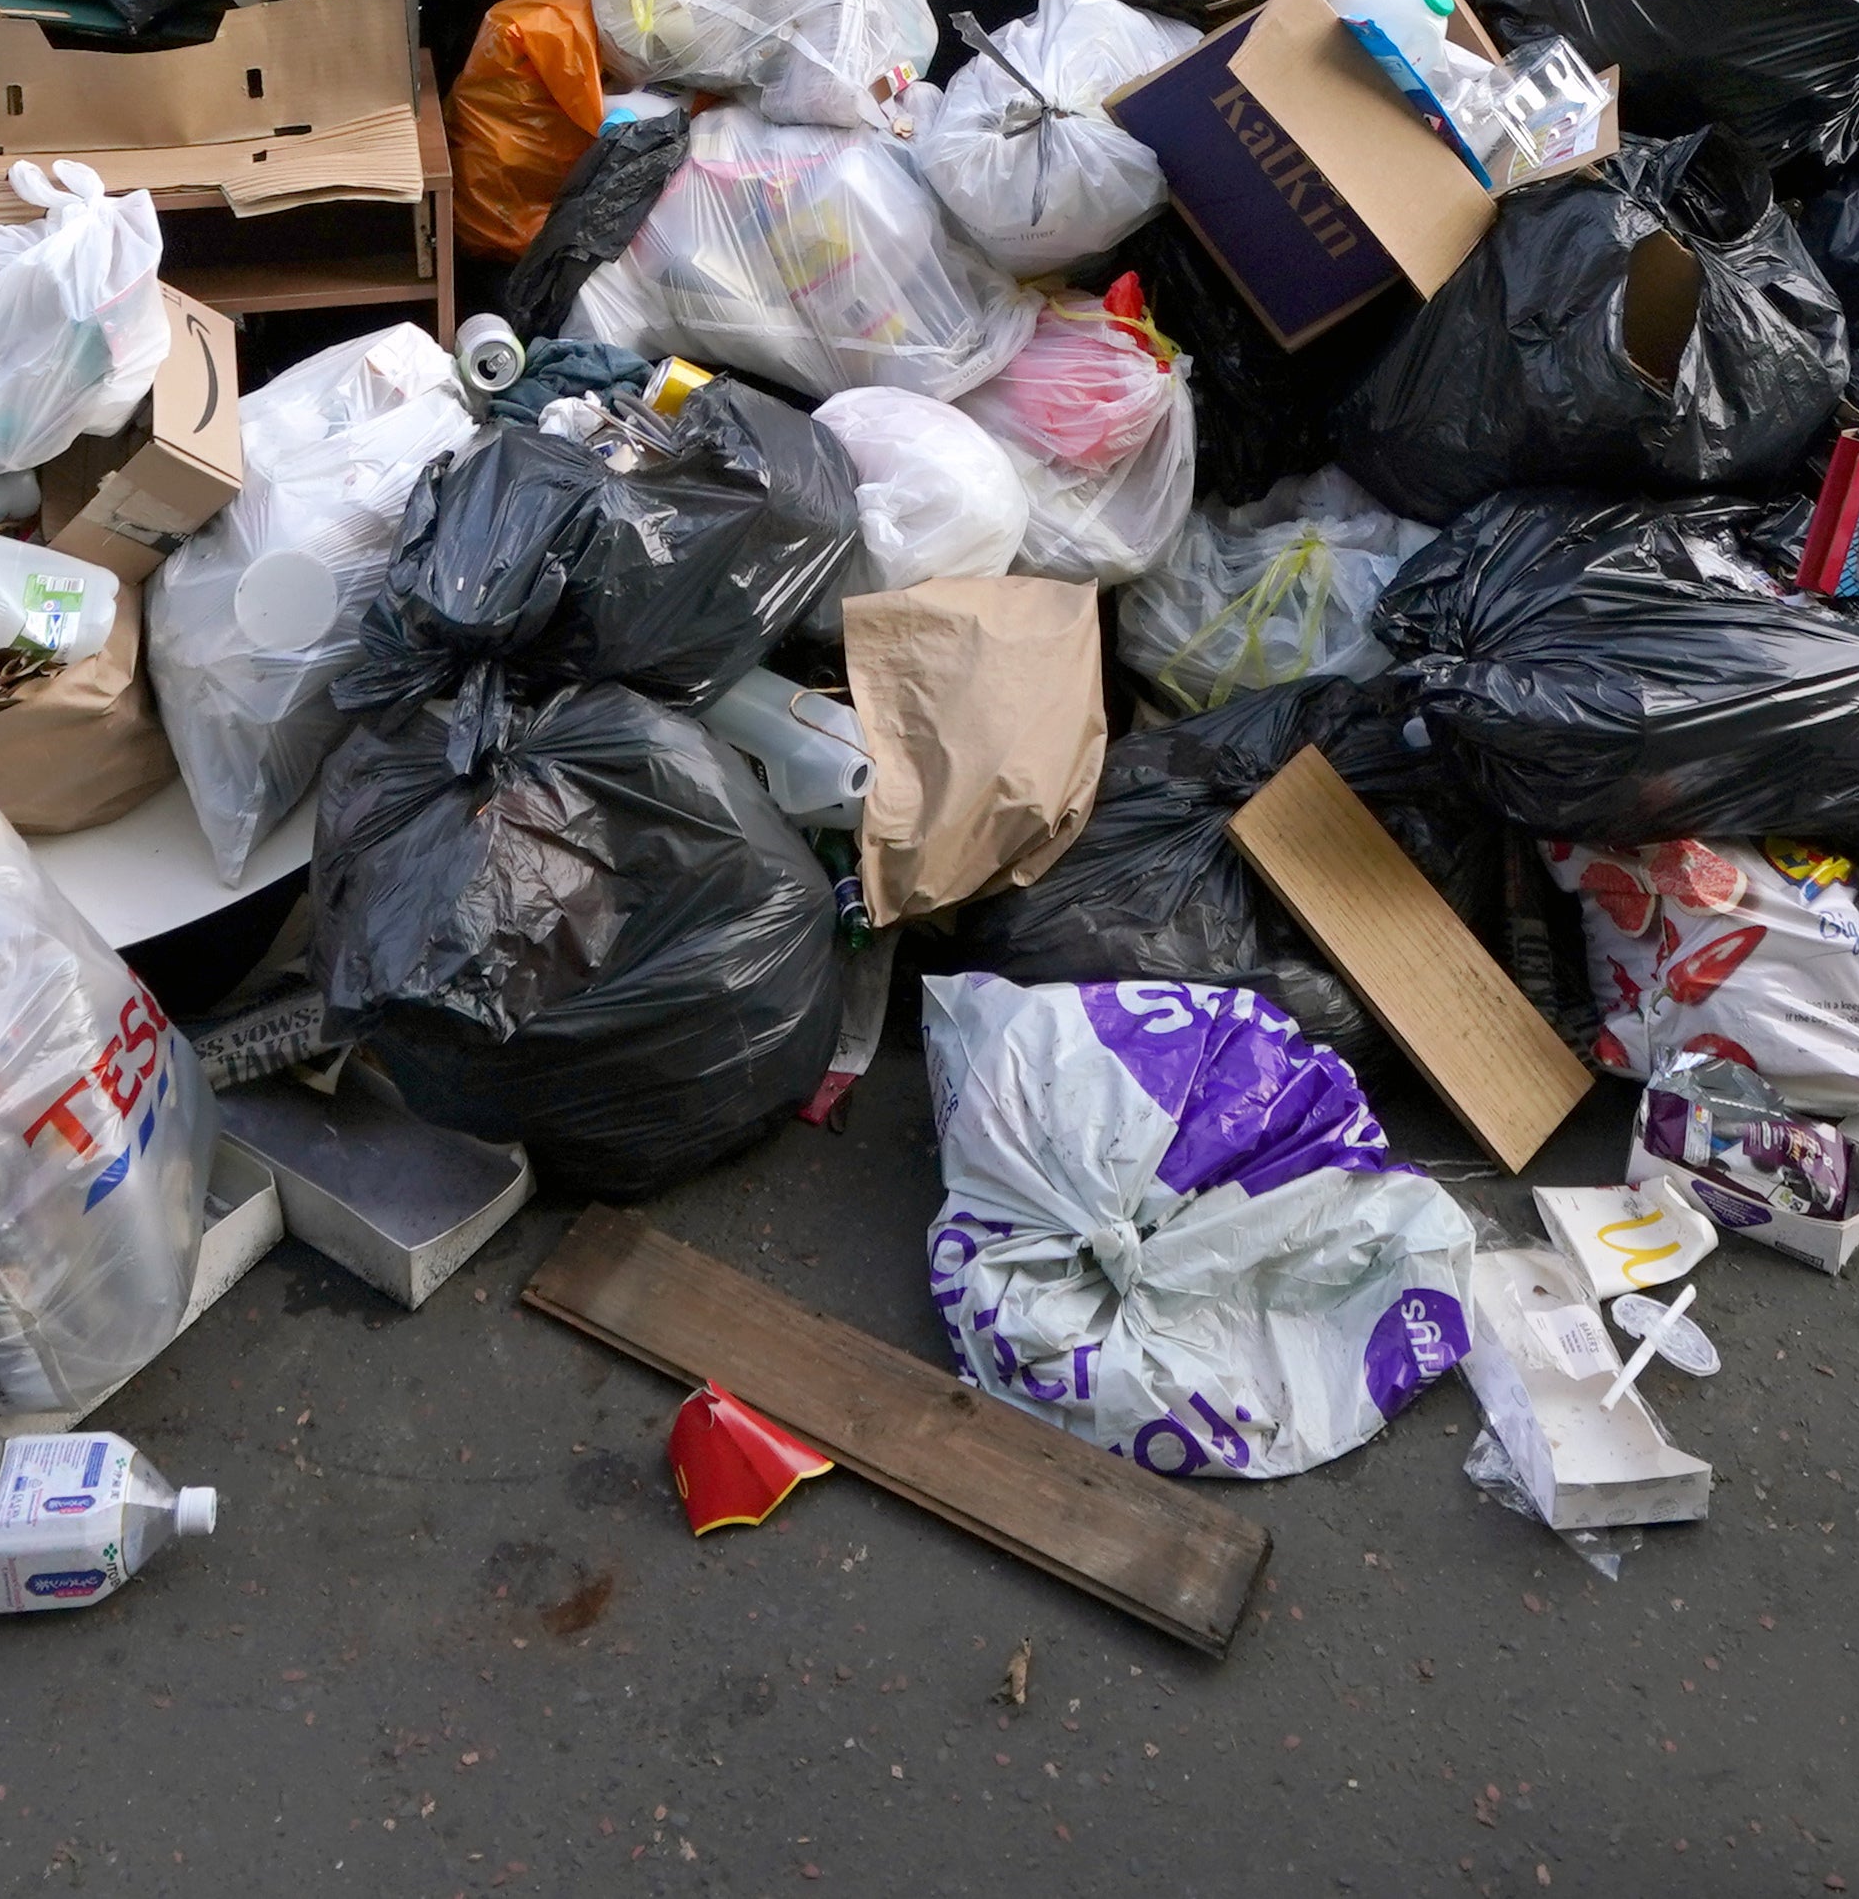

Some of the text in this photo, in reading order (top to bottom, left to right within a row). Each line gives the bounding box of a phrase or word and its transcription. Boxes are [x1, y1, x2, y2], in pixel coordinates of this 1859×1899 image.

[1020, 228, 1057, 243] liner
[1794, 1014, 1810, 1023] the
[231, 1006, 321, 1048] VOWS:
